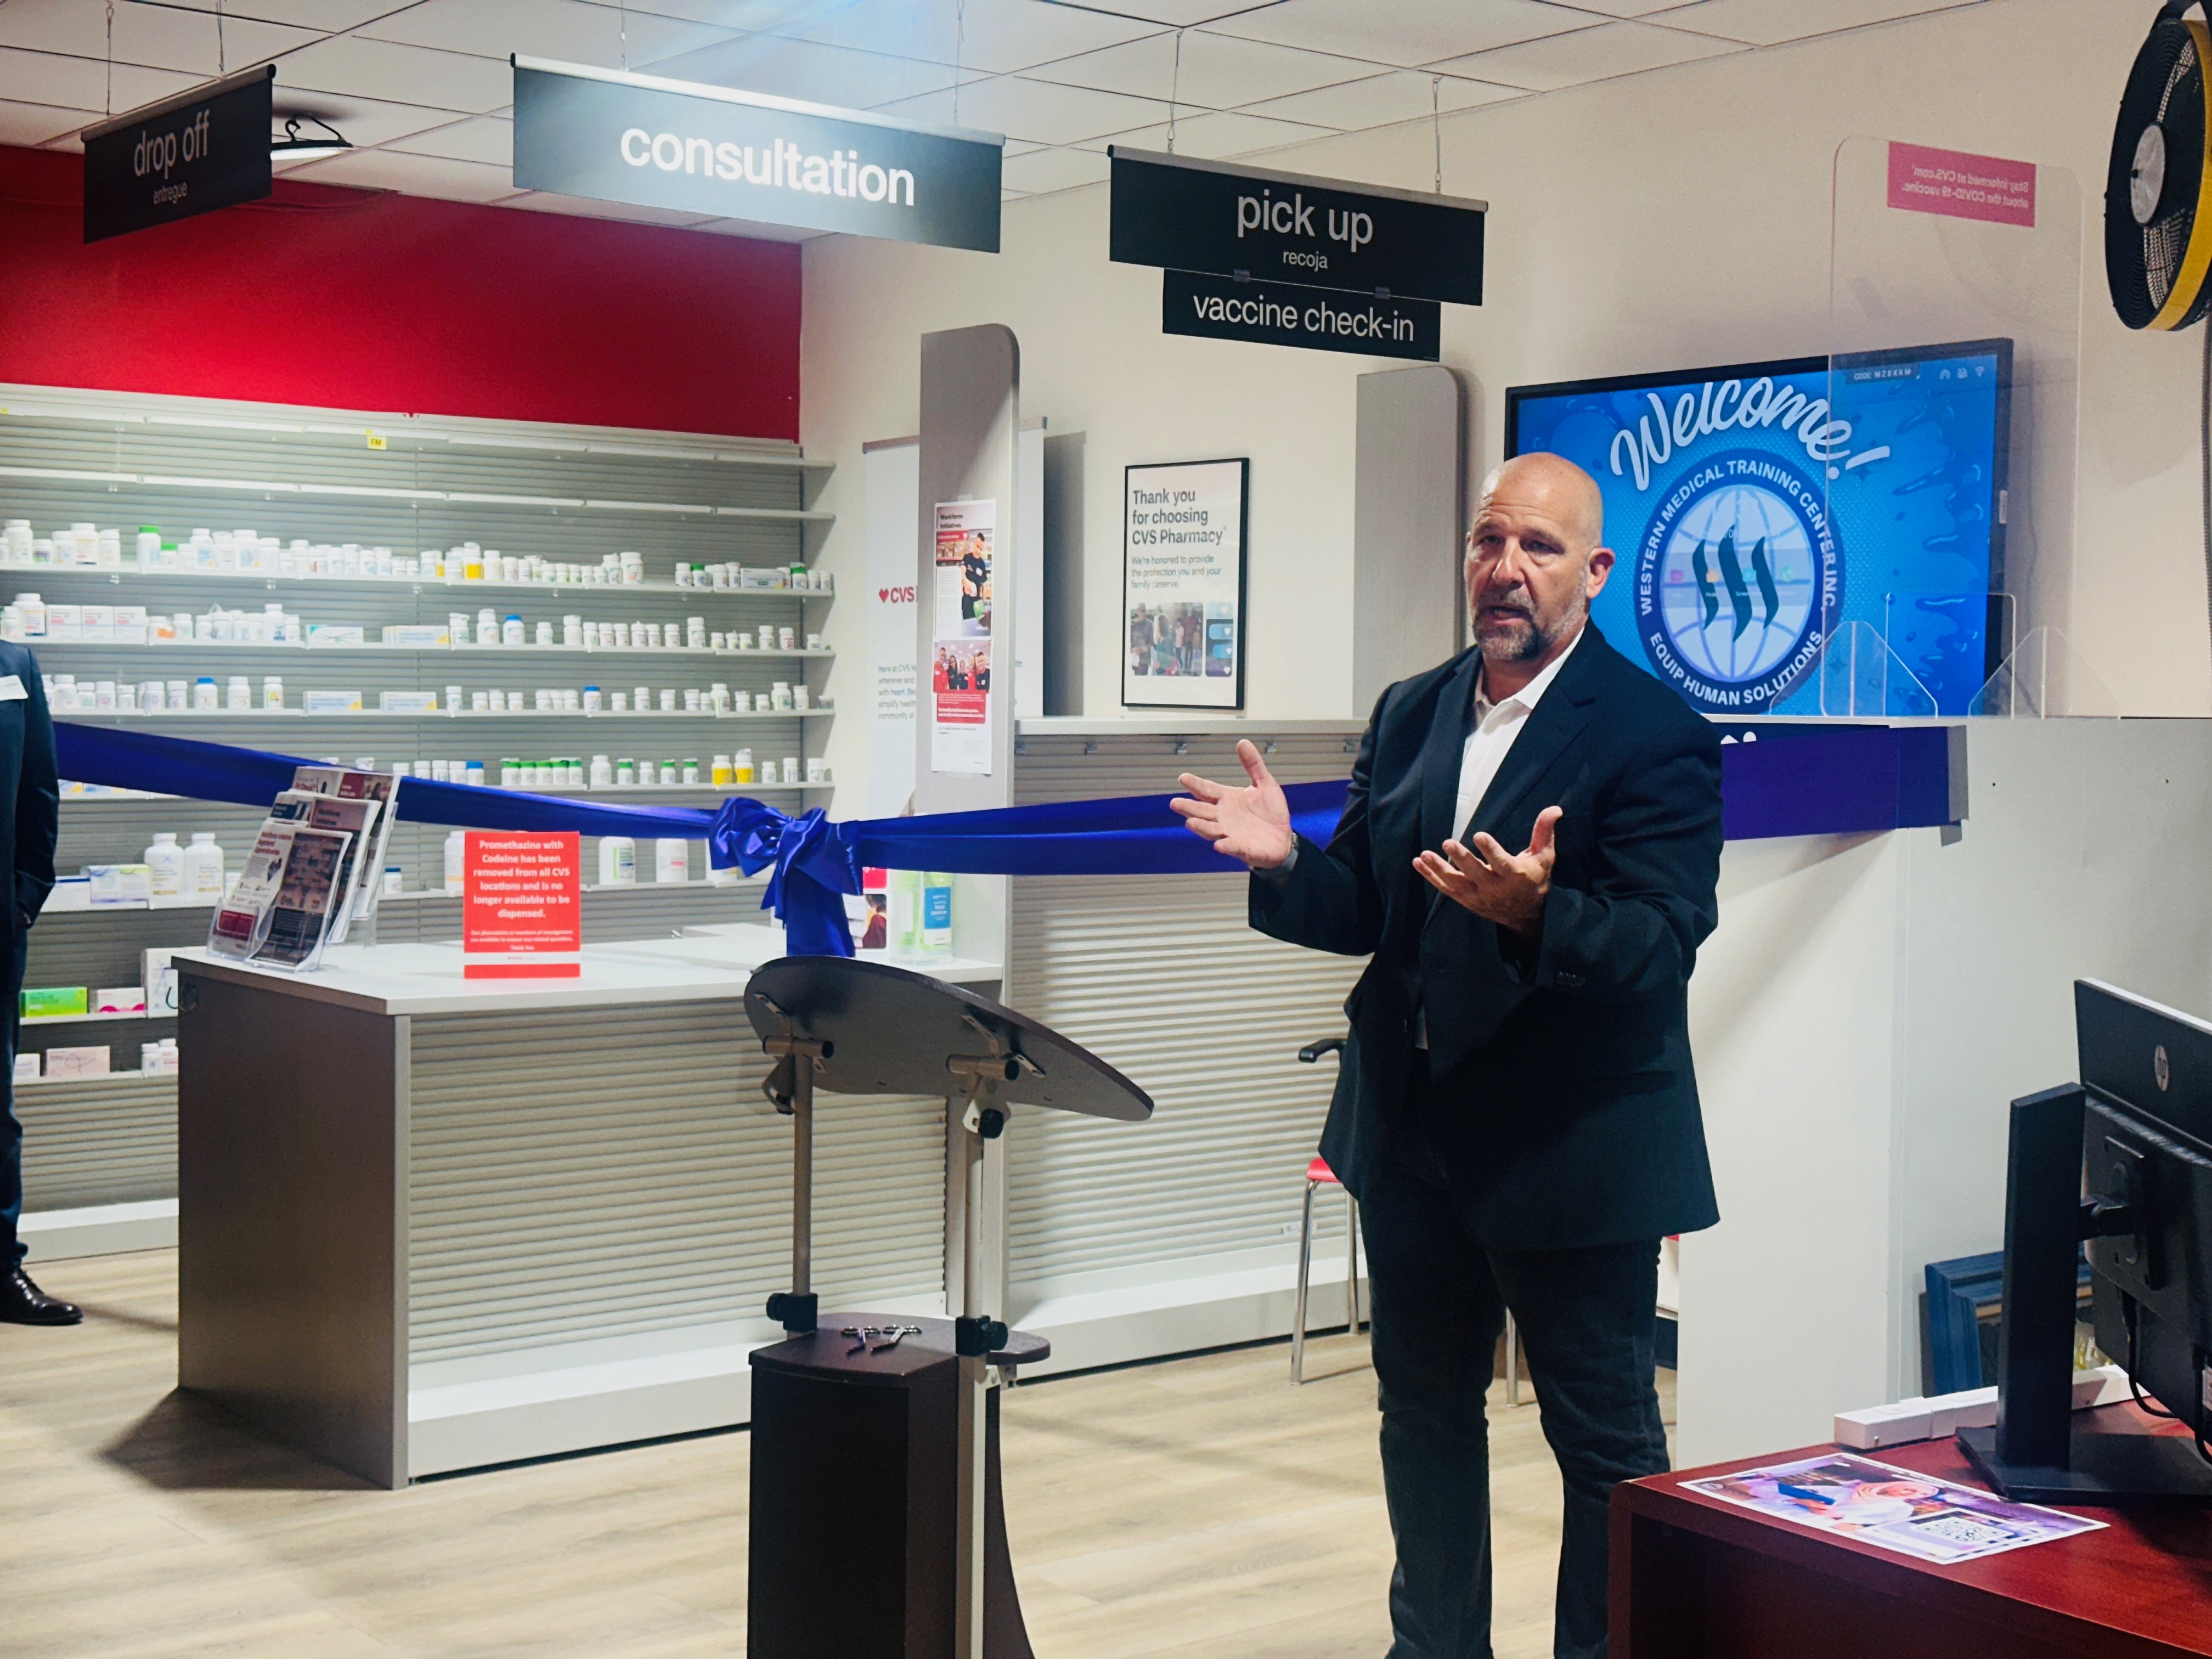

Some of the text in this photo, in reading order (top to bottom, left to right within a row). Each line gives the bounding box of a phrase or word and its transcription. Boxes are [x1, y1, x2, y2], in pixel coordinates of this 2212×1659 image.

[134, 109, 210, 180] drop off
[620, 128, 915, 206] consultation
[154, 182, 188, 204] entregue
[1238, 189, 1373, 252] pick up
[1283, 250, 1328, 272] recoja
[1193, 295, 1414, 341] vaccine check-in
[1610, 376, 1891, 491] Welcome!
[1133, 488, 1195, 506] Thank you
[1132, 506, 1208, 526] for choosing
[1132, 528, 1223, 546] CVS Pharmacy
[1641, 521, 1666, 616] WESTERN
[1661, 465, 1724, 522] MEDICAL
[1727, 459, 1801, 497] TRAINING
[1132, 556, 1150, 565] We're
[1152, 555, 1178, 565] honored
[1188, 554, 1214, 565] provide
[1143, 567, 1176, 577] protection
[1178, 568, 1190, 578] you
[1192, 567, 1205, 575] and
[1206, 568, 1222, 578] your
[890, 586, 918, 603] CVS
[1650, 630, 1822, 706] EQUIP HUMAN SOLUTIONS
[479, 839, 564, 850] Promethazine with
[482, 854, 561, 864] Codeine has been
[473, 867, 571, 877] removed from all CVS
[479, 881, 521, 890] locations
[522, 881, 540, 890] and
[541, 882, 549, 890] is
[473, 895, 571, 906] longer available to be
[497, 908, 546, 919] dispensed.
